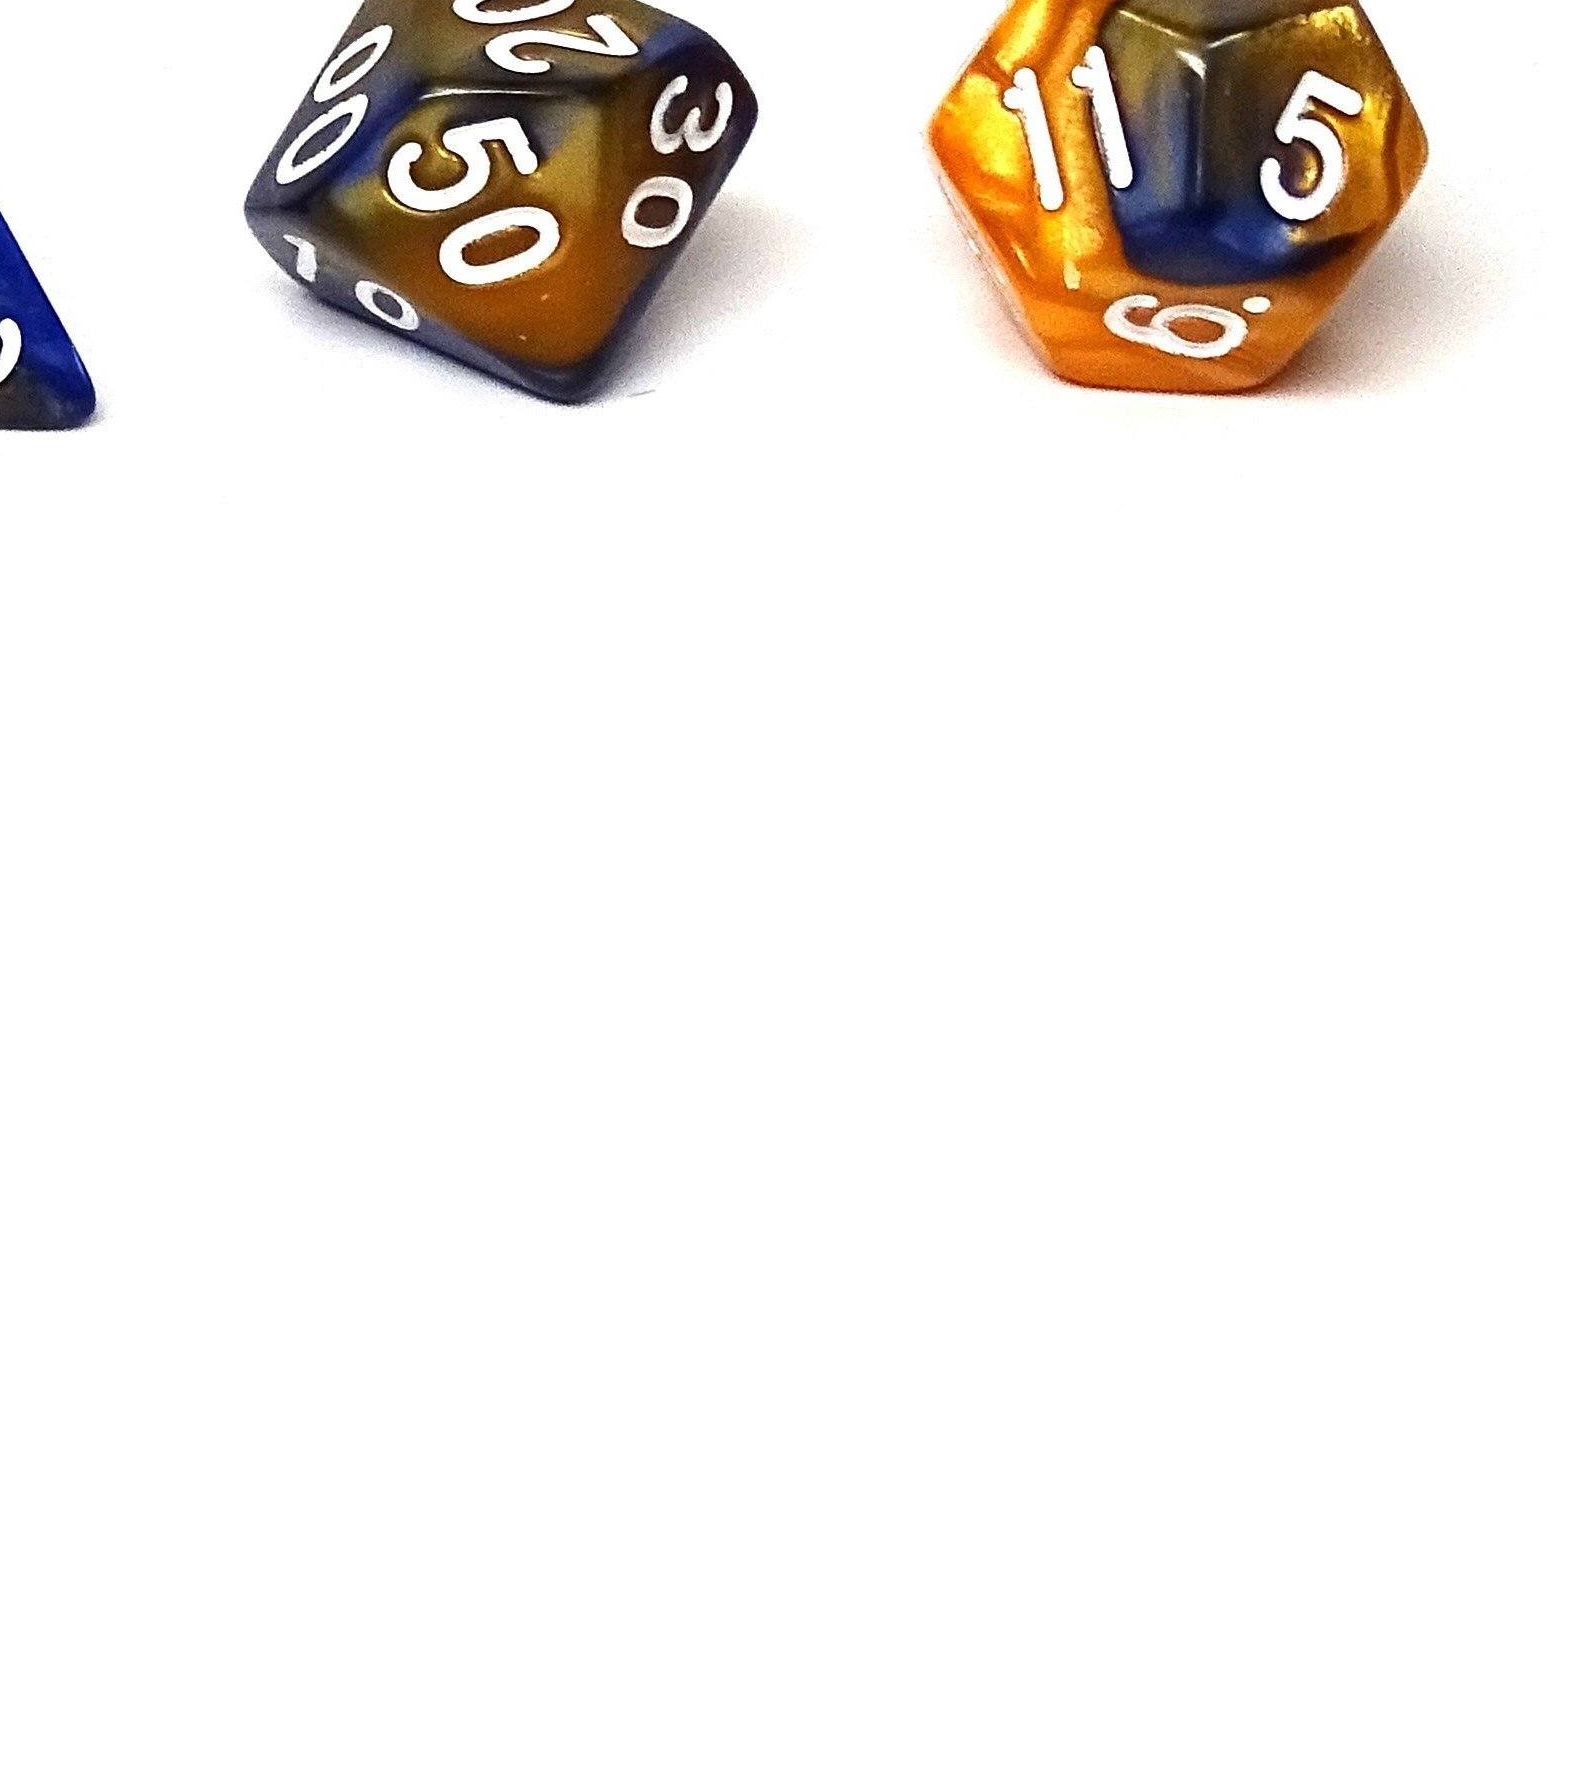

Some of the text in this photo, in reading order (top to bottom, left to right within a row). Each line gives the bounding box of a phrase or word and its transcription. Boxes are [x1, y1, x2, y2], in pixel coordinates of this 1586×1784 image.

[276, 24, 393, 185] 00
[621, 75, 734, 248] 30
[1003, 45, 1134, 211] 11
[1259, 70, 1363, 221] 5
[282, 234, 420, 330] 10
[387, 117, 561, 286] 50
